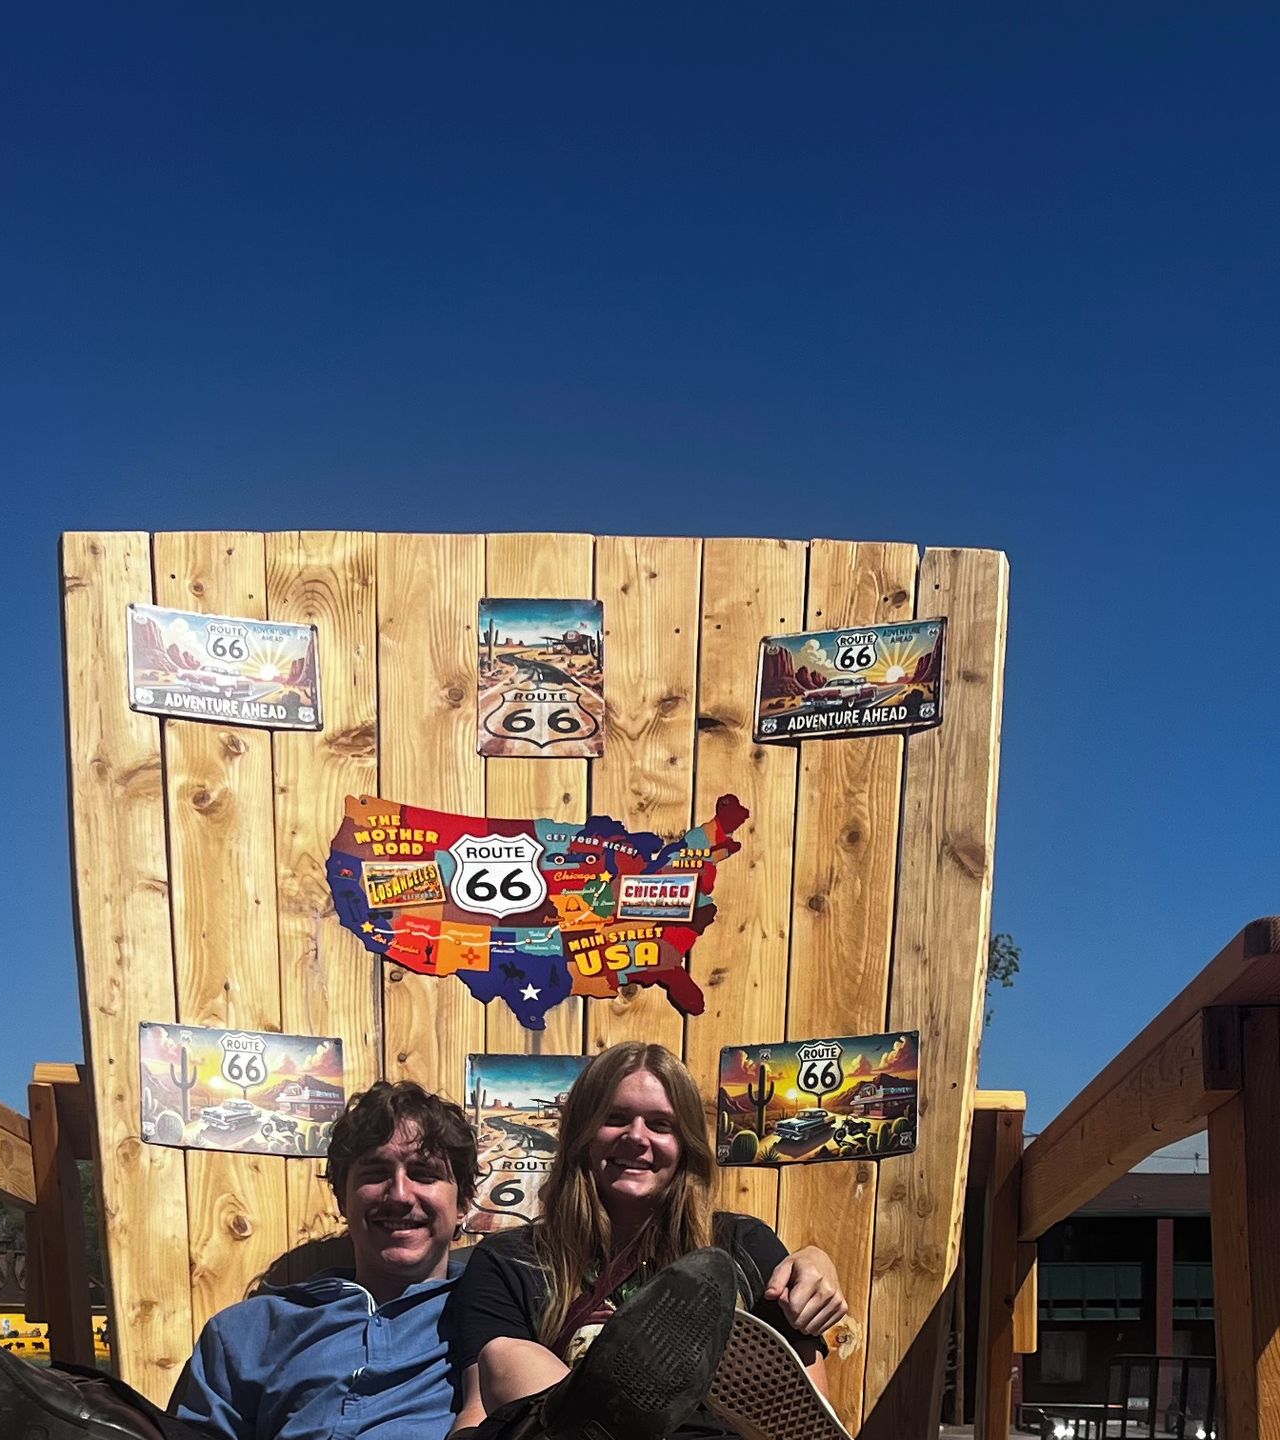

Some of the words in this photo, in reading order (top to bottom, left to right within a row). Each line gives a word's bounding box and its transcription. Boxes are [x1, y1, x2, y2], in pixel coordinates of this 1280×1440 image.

[210, 624, 244, 637] ROUTE
[212, 636, 244, 659] 66
[840, 634, 874, 646] ROUTE
[840, 645, 872, 669] 66
[513, 692, 568, 701] ROUTE
[164, 692, 239, 716] ADVENTURE
[241, 704, 288, 720] AHEAD
[502, 708, 581, 734] 66
[787, 709, 859, 731] ADVENTURE
[862, 705, 908, 724] AHEAD
[367, 814, 401, 827] THE
[353, 828, 439, 844] MOTHER
[372, 842, 424, 856] ROAD
[466, 846, 525, 859] ROUTE
[546, 833, 566, 841] GET
[570, 835, 600, 846] YOUR
[602, 841, 638, 857] KICKS!
[679, 848, 711, 858] 2448
[672, 860, 703, 868] MILES
[554, 870, 597, 883] Chicago
[466, 868, 532, 902] 66
[624, 885, 689, 898] CHICAGO
[568, 937, 605, 952] MAIN
[607, 926, 663, 943] STREET
[574, 941, 659, 976] USA
[227, 1039, 260, 1051] ROUTE
[803, 1047, 838, 1059] ROUTE
[228, 1053, 261, 1082] 66
[803, 1061, 837, 1090] 66
